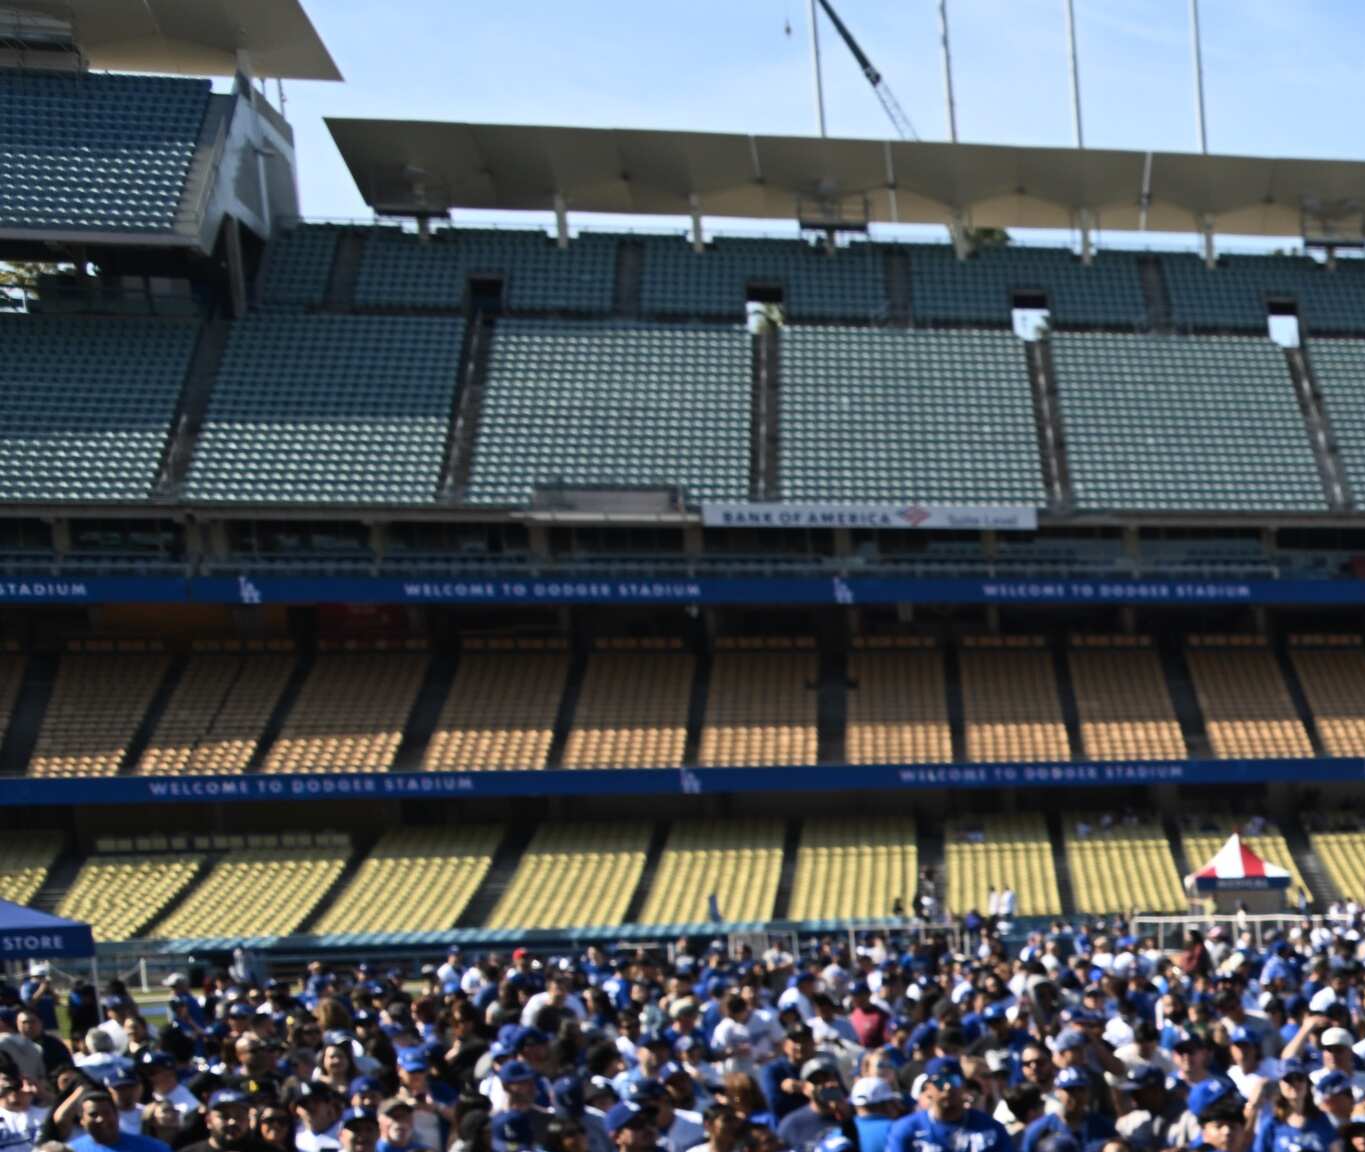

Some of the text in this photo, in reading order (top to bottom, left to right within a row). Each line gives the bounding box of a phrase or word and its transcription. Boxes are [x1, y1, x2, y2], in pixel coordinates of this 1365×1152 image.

[722, 511, 892, 525] BANK OF AMERICA
[404, 583, 701, 598] WELCOME TO DODGER STADIUM
[983, 584, 1064, 597] WELCOME
[1071, 584, 1094, 597] TO
[150, 777, 474, 796] WELCOME TO DODGER STADIUM
[2, 935, 63, 951] STORE
